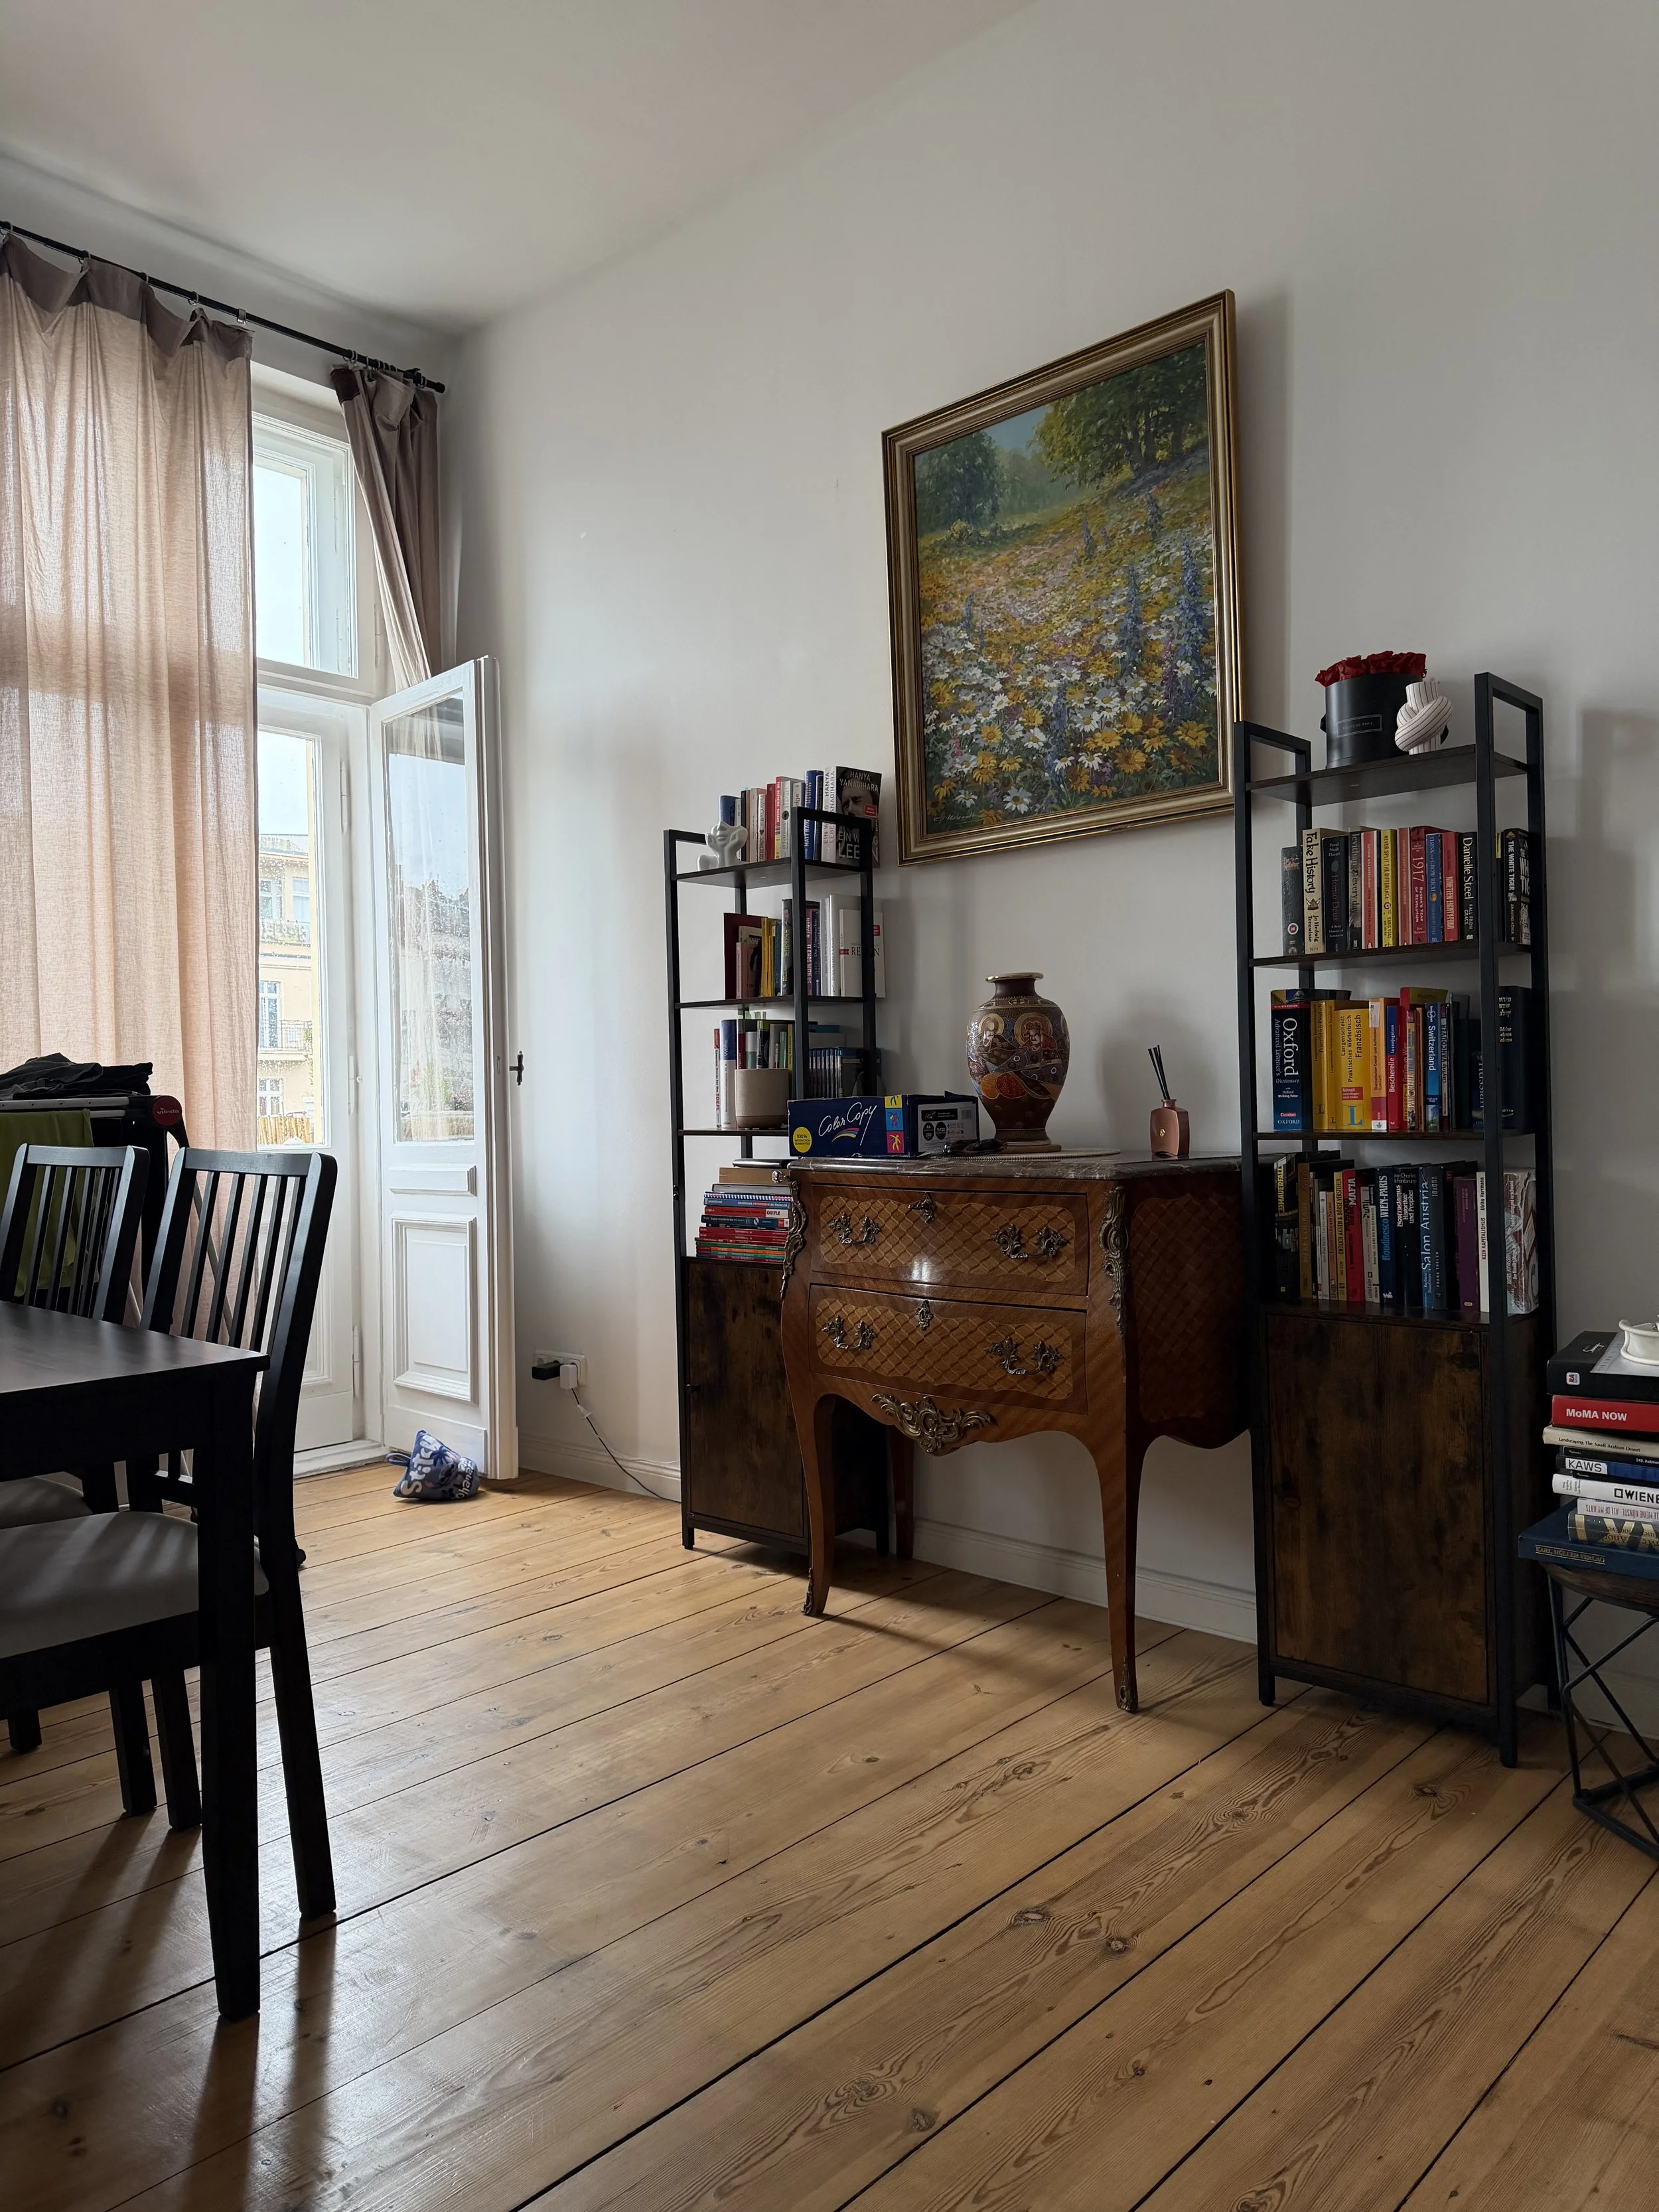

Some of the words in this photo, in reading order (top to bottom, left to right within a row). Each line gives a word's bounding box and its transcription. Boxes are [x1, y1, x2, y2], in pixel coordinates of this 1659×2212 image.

[839, 778, 879, 792] YANAGIHARA
[850, 771, 871, 781] HANYA
[838, 830, 851, 842] EIN
[1305, 831, 1319, 856] Fake
[1463, 837, 1473, 875] Danielle
[1305, 857, 1319, 893] History
[1412, 857, 1424, 882] 1917
[1463, 875, 1474, 899] Steel
[851, 946, 880, 956] REN
[1283, 1017, 1299, 1076] Oxford
[818, 1115, 845, 1136] Color
[847, 1102, 877, 1146] Copy
[1348, 1106, 1363, 1126] L
[1348, 1178, 1356, 1206] MAFIA
[1378, 1175, 1390, 1218] WIEN-PARIS
[1419, 1178, 1430, 1230] Austria
[1382, 1218, 1391, 1261] Roudinesco
[1421, 1234, 1431, 1270] Salon
[1566, 1408, 1599, 1419] MoMA
[1602, 1412, 1627, 1422] NOW
[1568, 1459, 1602, 1473] KAWS
[1585, 1504, 1597, 1512] ARTS
[1623, 1509, 1639, 1518] KÜNSTE
[1639, 1510, 1653, 1518] MEINE
